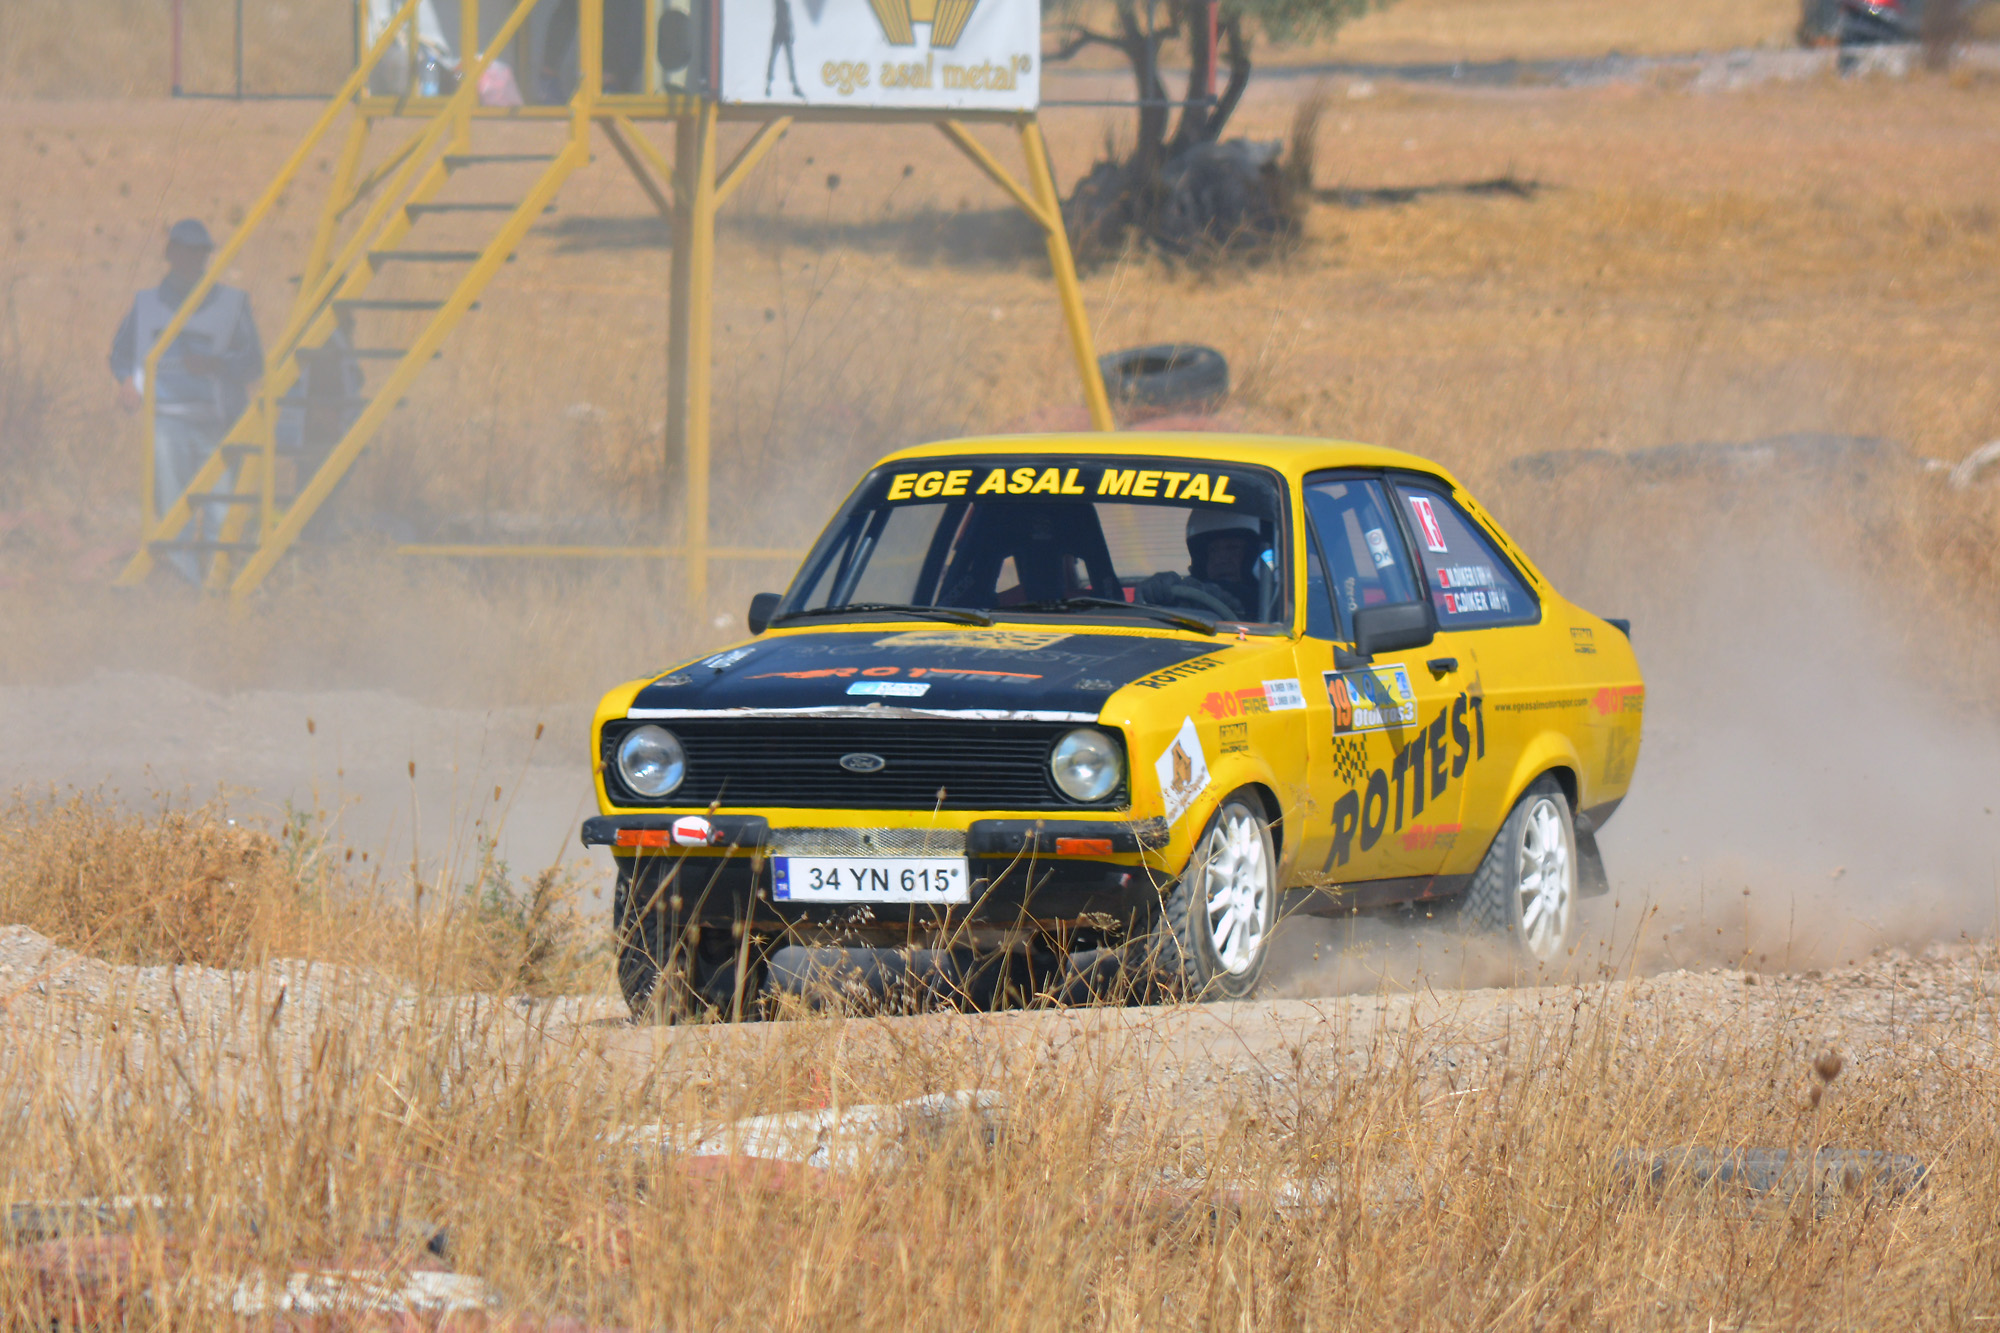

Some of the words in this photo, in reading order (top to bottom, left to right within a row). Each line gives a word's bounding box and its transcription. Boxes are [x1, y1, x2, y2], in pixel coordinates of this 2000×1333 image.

[821, 61, 870, 95] ege
[880, 53, 933, 89] asal
[887, 469, 974, 501] EGE
[976, 467, 1086, 495] ASAL
[1097, 468, 1237, 504] METAL
[1373, 550, 1392, 565] OK
[1134, 657, 1224, 690] ROTTEST
[1204, 687, 1266, 720] ROT
[1241, 696, 1273, 716] FIRE
[1328, 678, 1352, 726] 19
[1322, 692, 1485, 873] ROTTEST
[809, 867, 841, 891] 34
[849, 868, 889, 891] YN
[900, 868, 950, 892] 615
